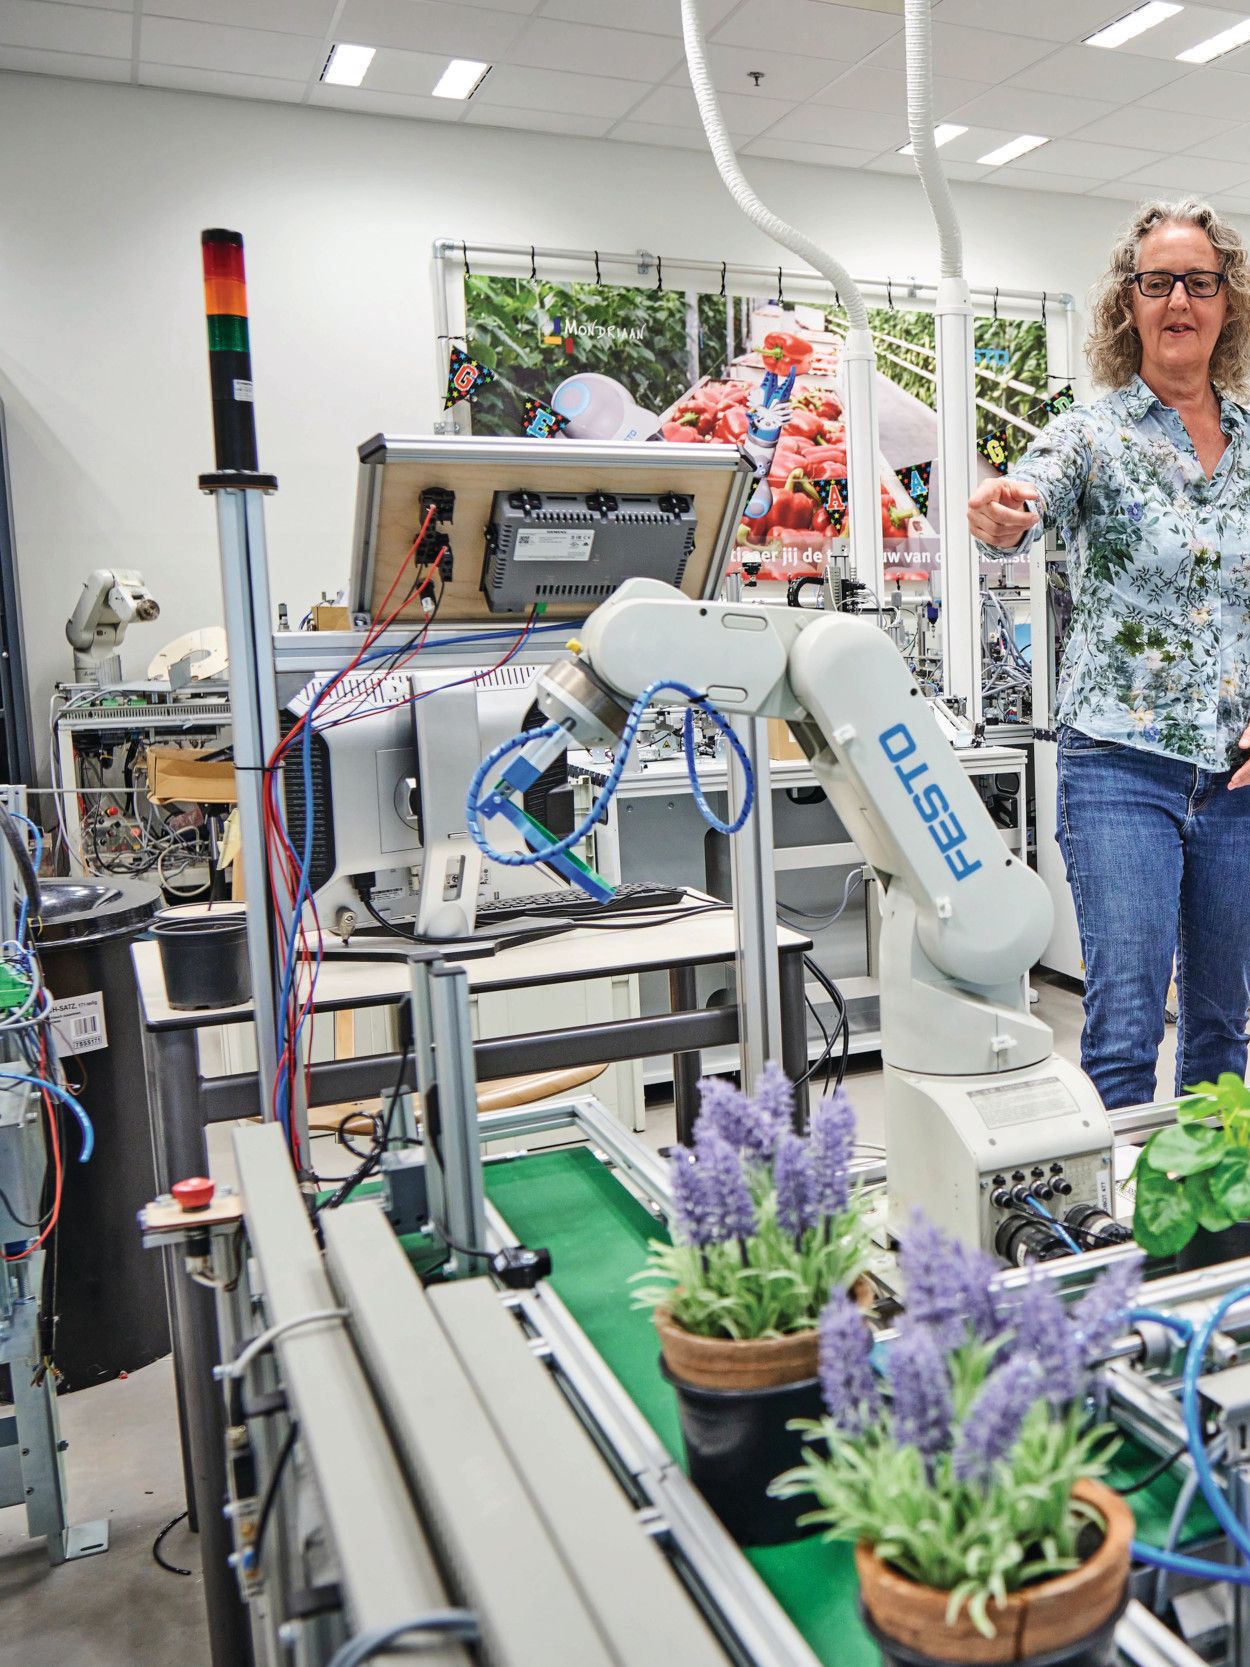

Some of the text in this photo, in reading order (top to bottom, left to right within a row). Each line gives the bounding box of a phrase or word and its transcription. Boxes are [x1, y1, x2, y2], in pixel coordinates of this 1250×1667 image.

[564, 317, 647, 340] MONDRIAAN
[975, 348, 1010, 366] STO
[454, 364, 478, 391] G
[527, 408, 555, 438] E
[986, 439, 1004, 464] G
[909, 470, 928, 497] A
[827, 485, 846, 511] A
[782, 547, 798, 566] jij
[802, 547, 823, 563] de
[904, 551, 931, 564] van
[878, 723, 983, 882] FESTO
